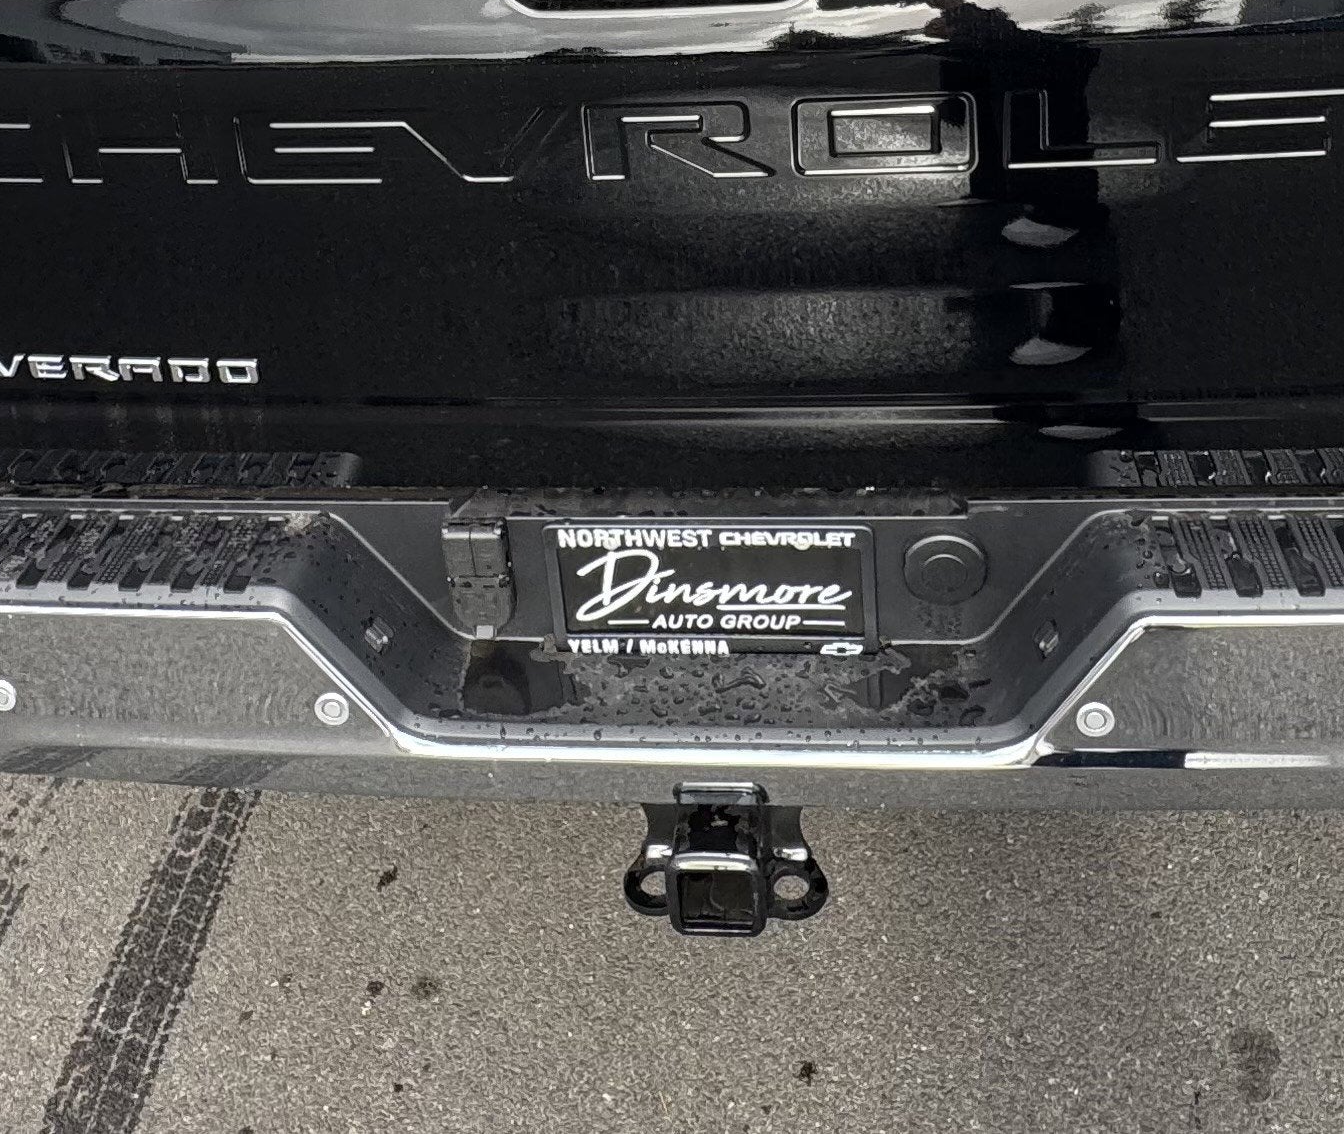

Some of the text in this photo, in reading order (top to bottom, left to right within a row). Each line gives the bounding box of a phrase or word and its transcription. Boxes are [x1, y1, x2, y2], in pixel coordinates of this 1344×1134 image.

[557, 528, 856, 550] NORTHWEST CHEVROLET
[576, 549, 853, 622] Dinsmore
[651, 614, 802, 631] AUTO GROUP
[566, 639, 621, 654] YELM
